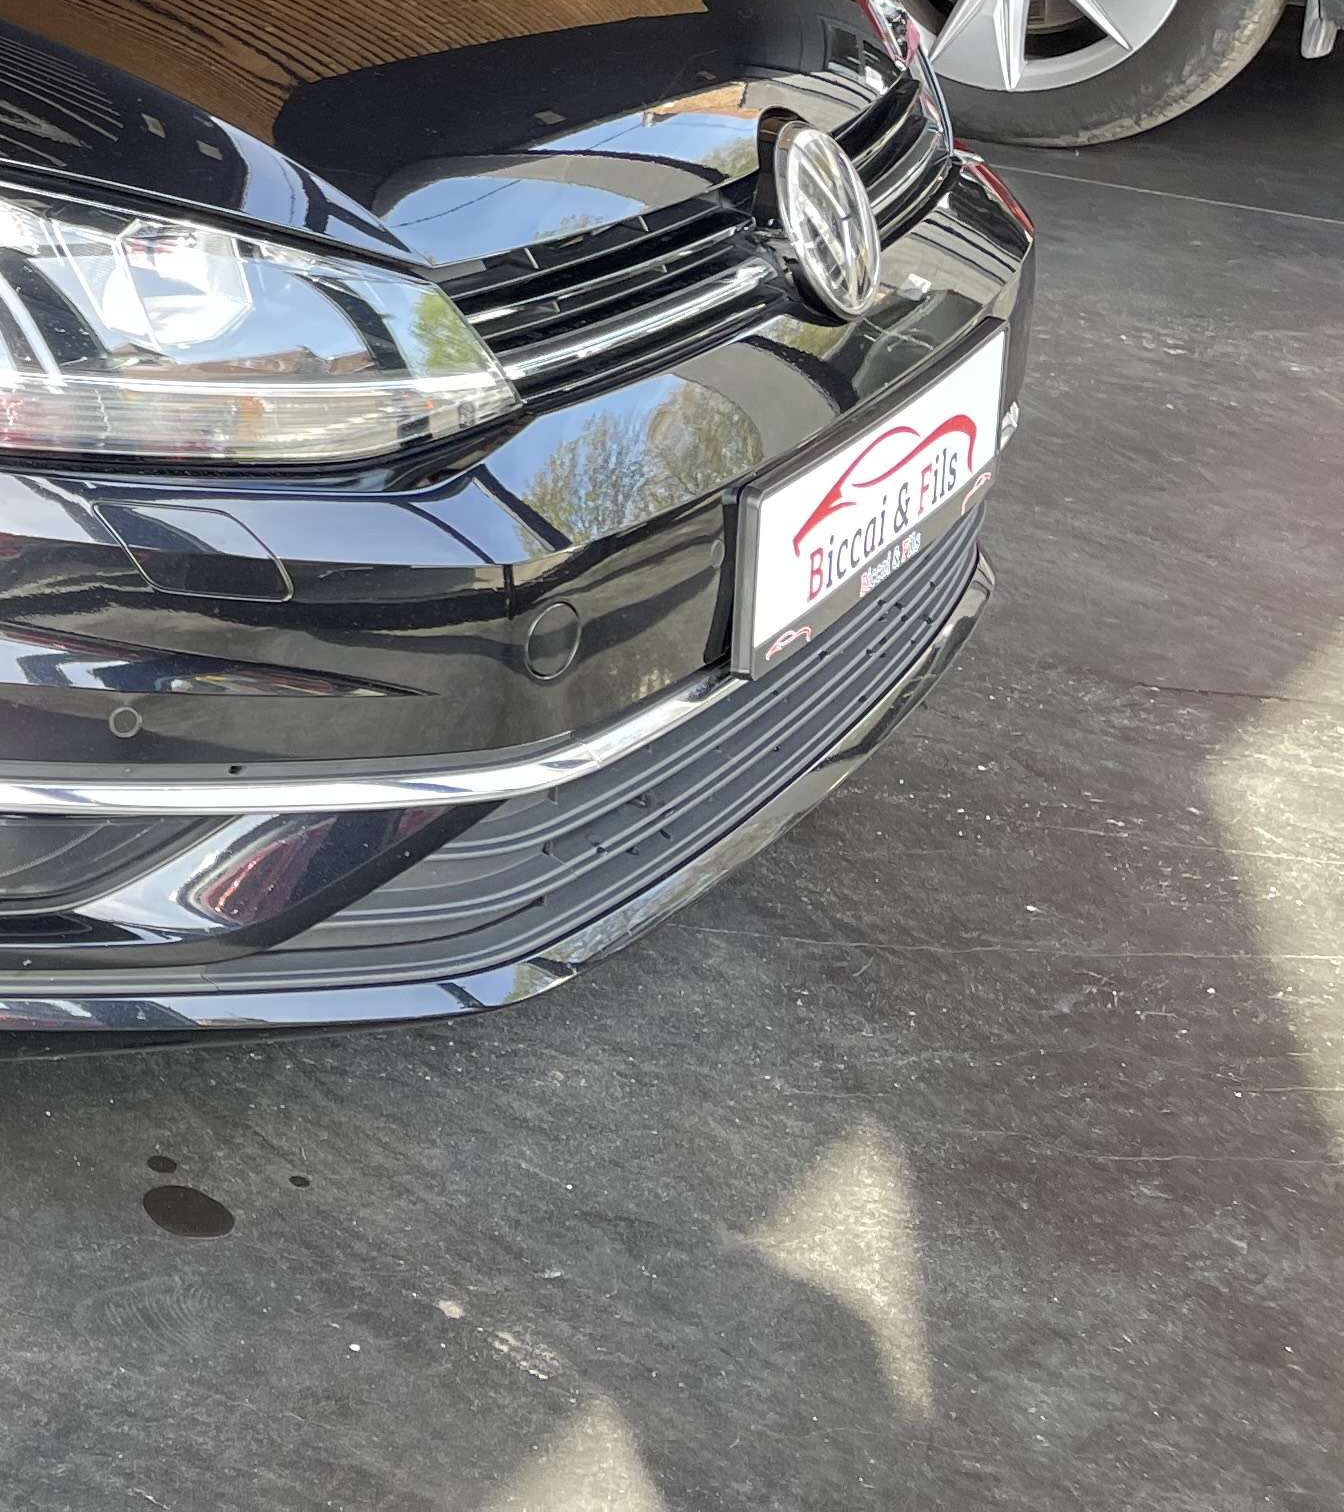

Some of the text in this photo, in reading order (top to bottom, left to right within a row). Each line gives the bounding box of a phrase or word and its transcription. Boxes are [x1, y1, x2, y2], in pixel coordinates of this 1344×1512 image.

[806, 446, 959, 603] Biccai & Fils
